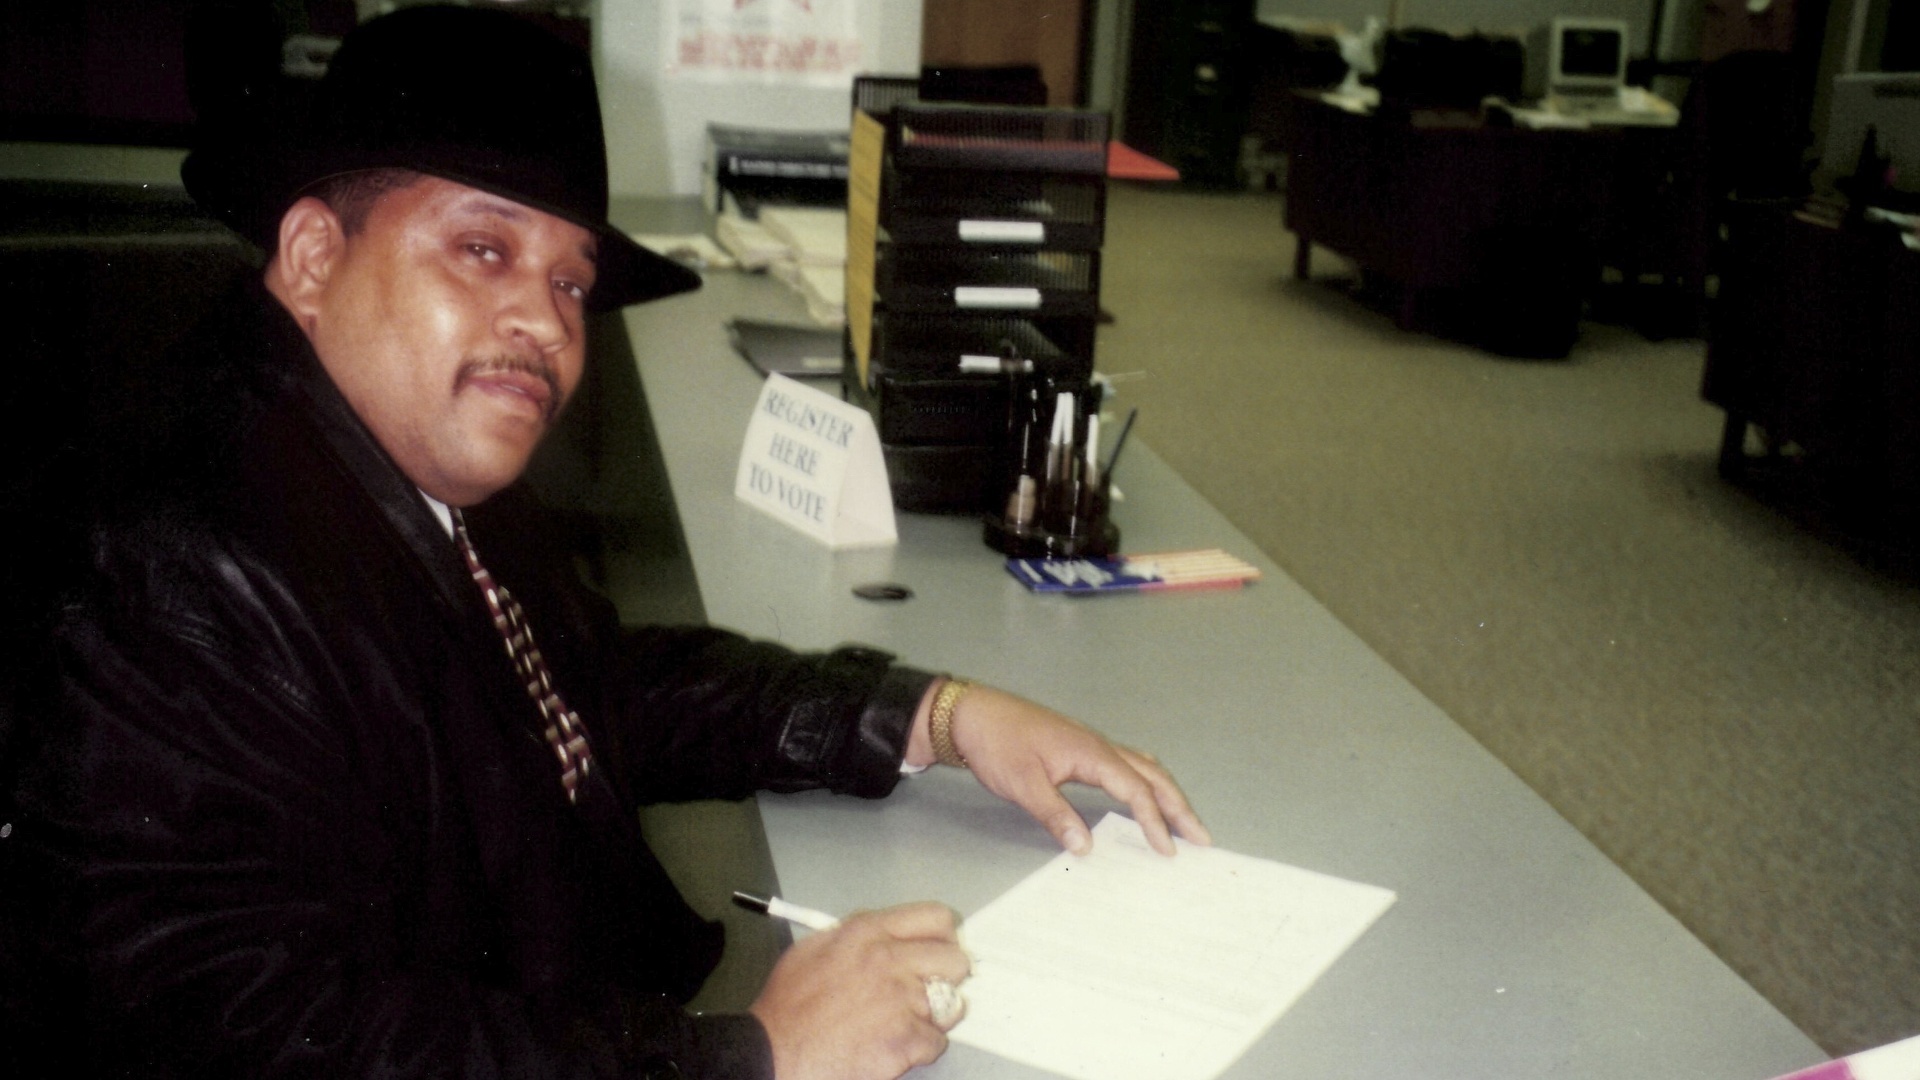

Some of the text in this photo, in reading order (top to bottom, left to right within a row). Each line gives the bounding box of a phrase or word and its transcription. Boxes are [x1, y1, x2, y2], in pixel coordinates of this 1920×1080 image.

[763, 389, 854, 448] REGISTER
[768, 432, 820, 476] HERE
[749, 462, 826, 522] TO VOTE
